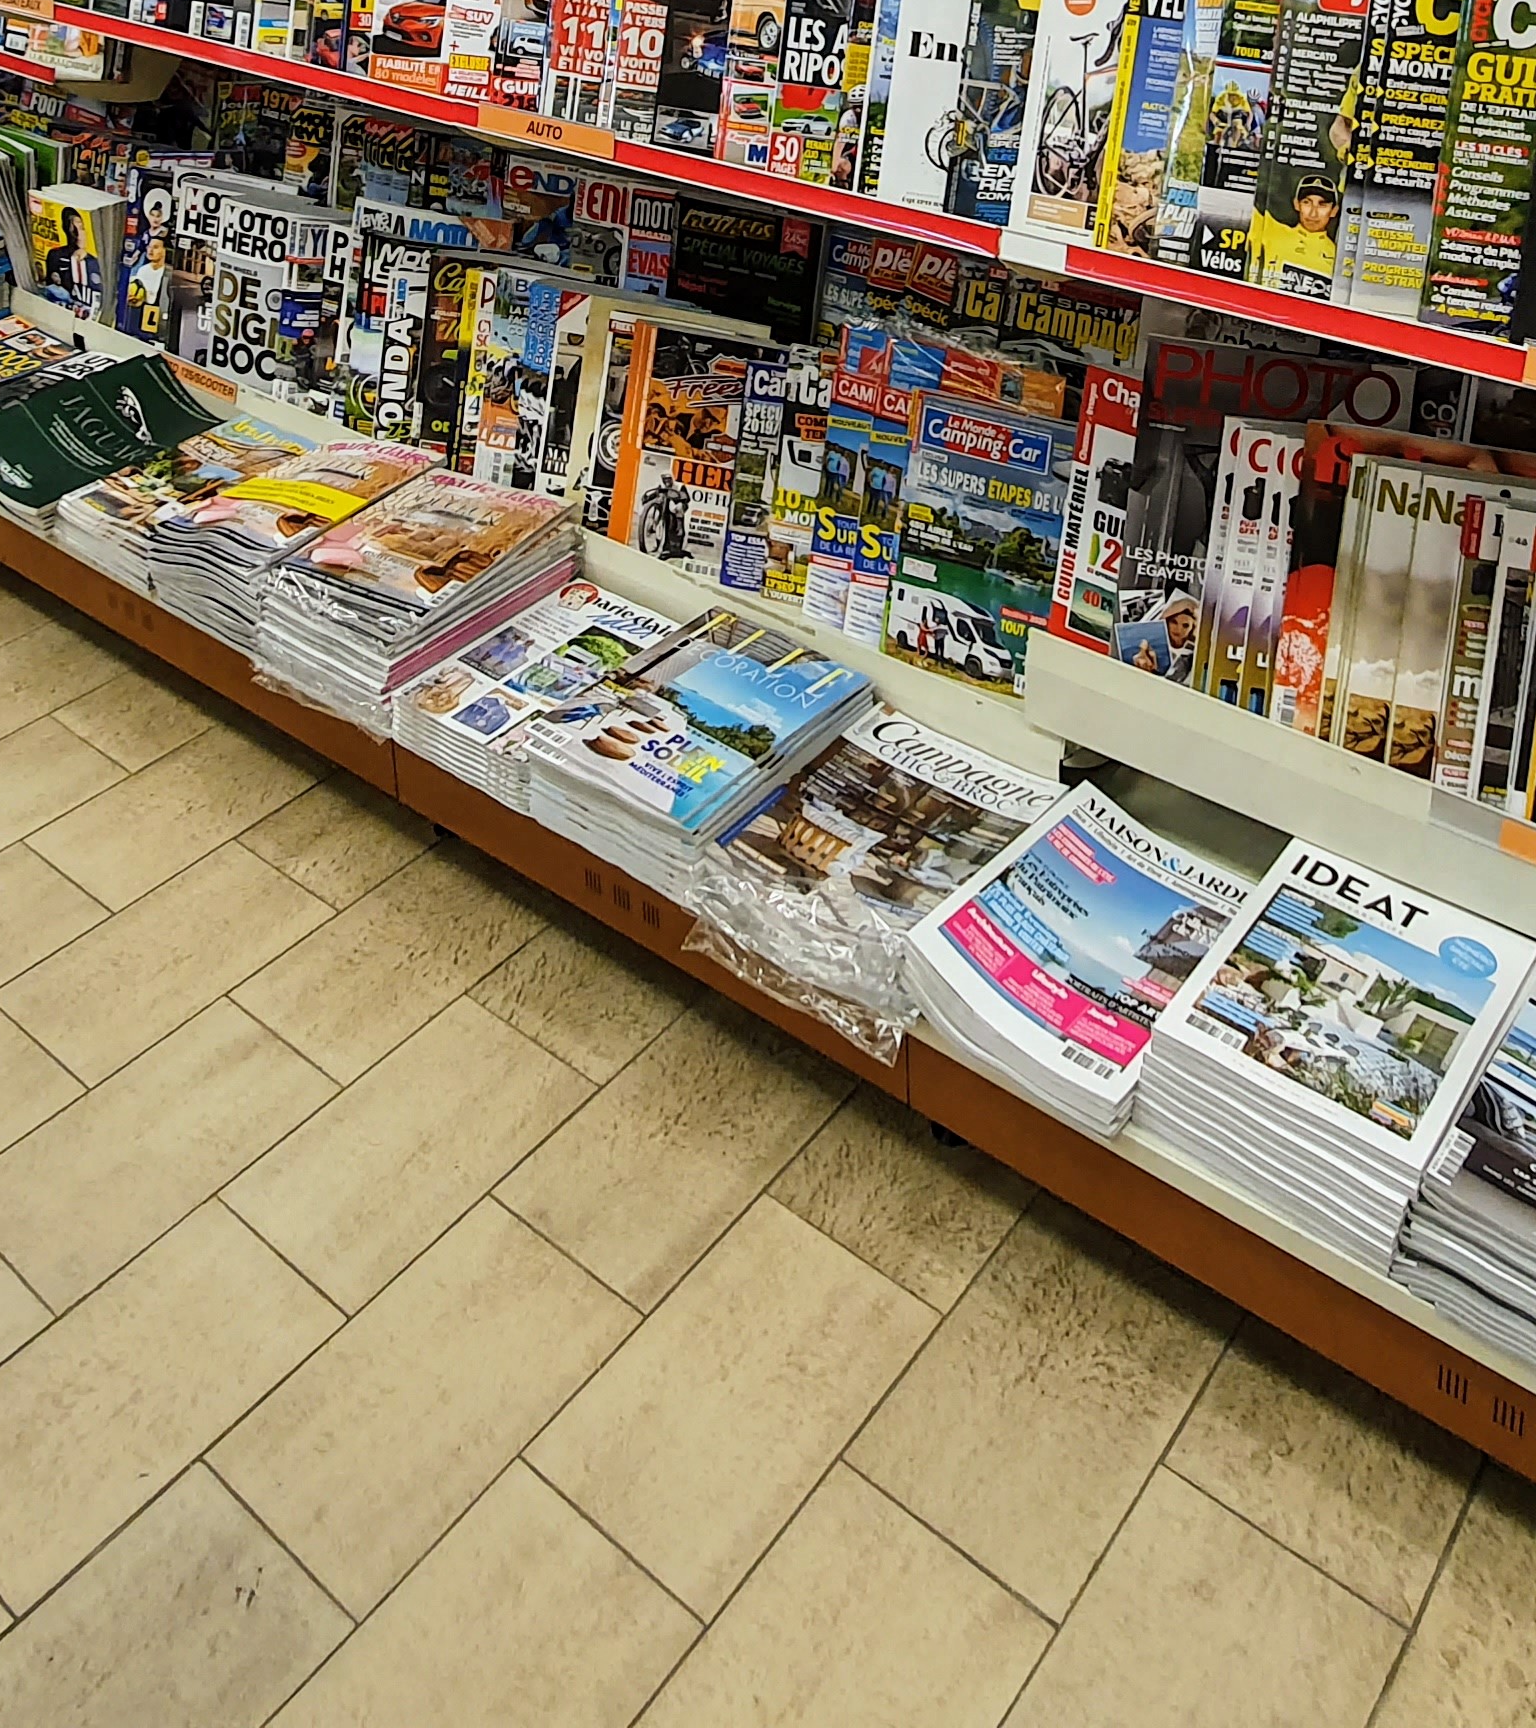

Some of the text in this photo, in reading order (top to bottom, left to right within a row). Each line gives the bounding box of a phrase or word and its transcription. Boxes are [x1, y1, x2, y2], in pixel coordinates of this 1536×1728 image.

[1295, 12, 1362, 30] ALAPHILIPPE
[1291, 48, 1338, 63] MERCATO
[525, 120, 564, 141] AUTO
[770, 135, 800, 162] 50
[770, 159, 800, 175] PAGES
[1451, 166, 1505, 184] Conseils
[1448, 180, 1530, 201] Programmes
[1446, 193, 1511, 211] Méthodes
[1445, 205, 1498, 223] Astuces
[59, 392, 152, 466] JAGUAR
[1057, 468, 1090, 601] GUIDE MATÉRIEL
[870, 719, 1057, 809] Campagne
[1291, 851, 1430, 930] IDEAT
